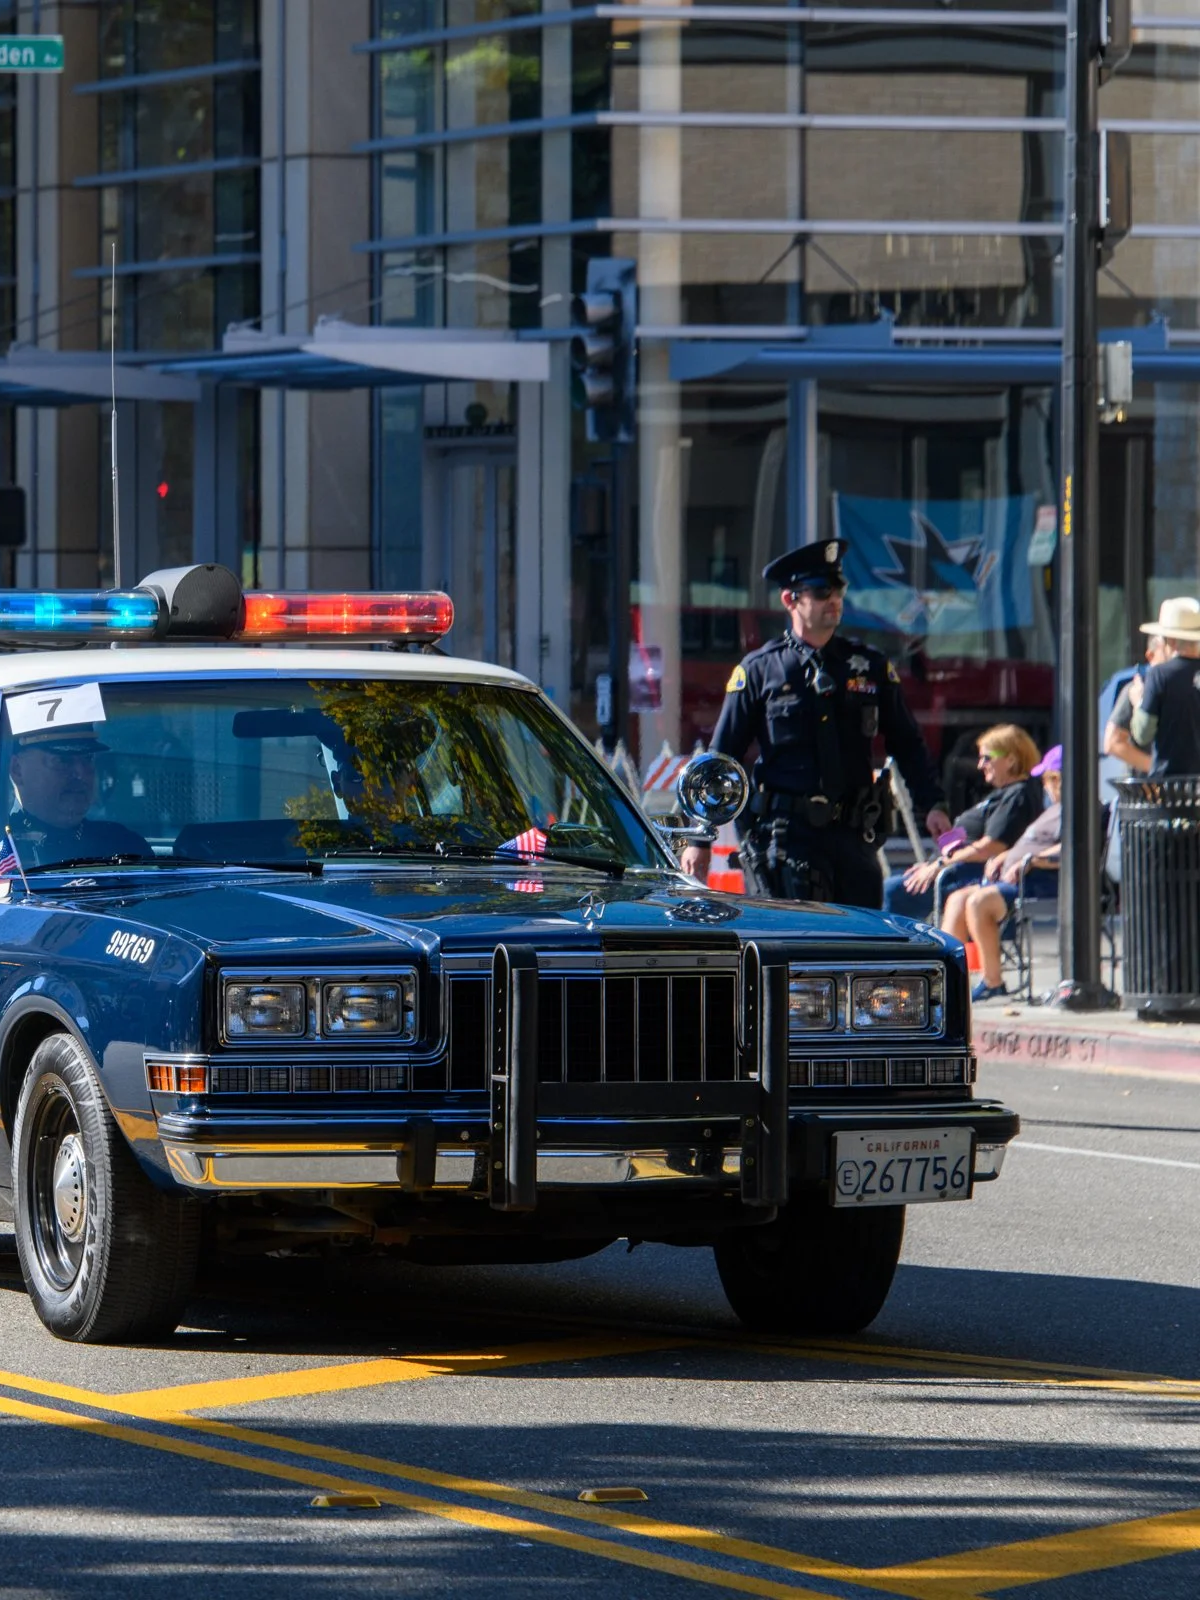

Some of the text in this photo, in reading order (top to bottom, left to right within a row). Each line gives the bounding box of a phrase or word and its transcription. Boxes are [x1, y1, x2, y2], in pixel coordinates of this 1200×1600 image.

[37, 697, 63, 722] 7
[105, 929, 155, 964] 99769
[866, 1139, 941, 1153] CALIFORNIA
[861, 1154, 967, 1195] 267756
